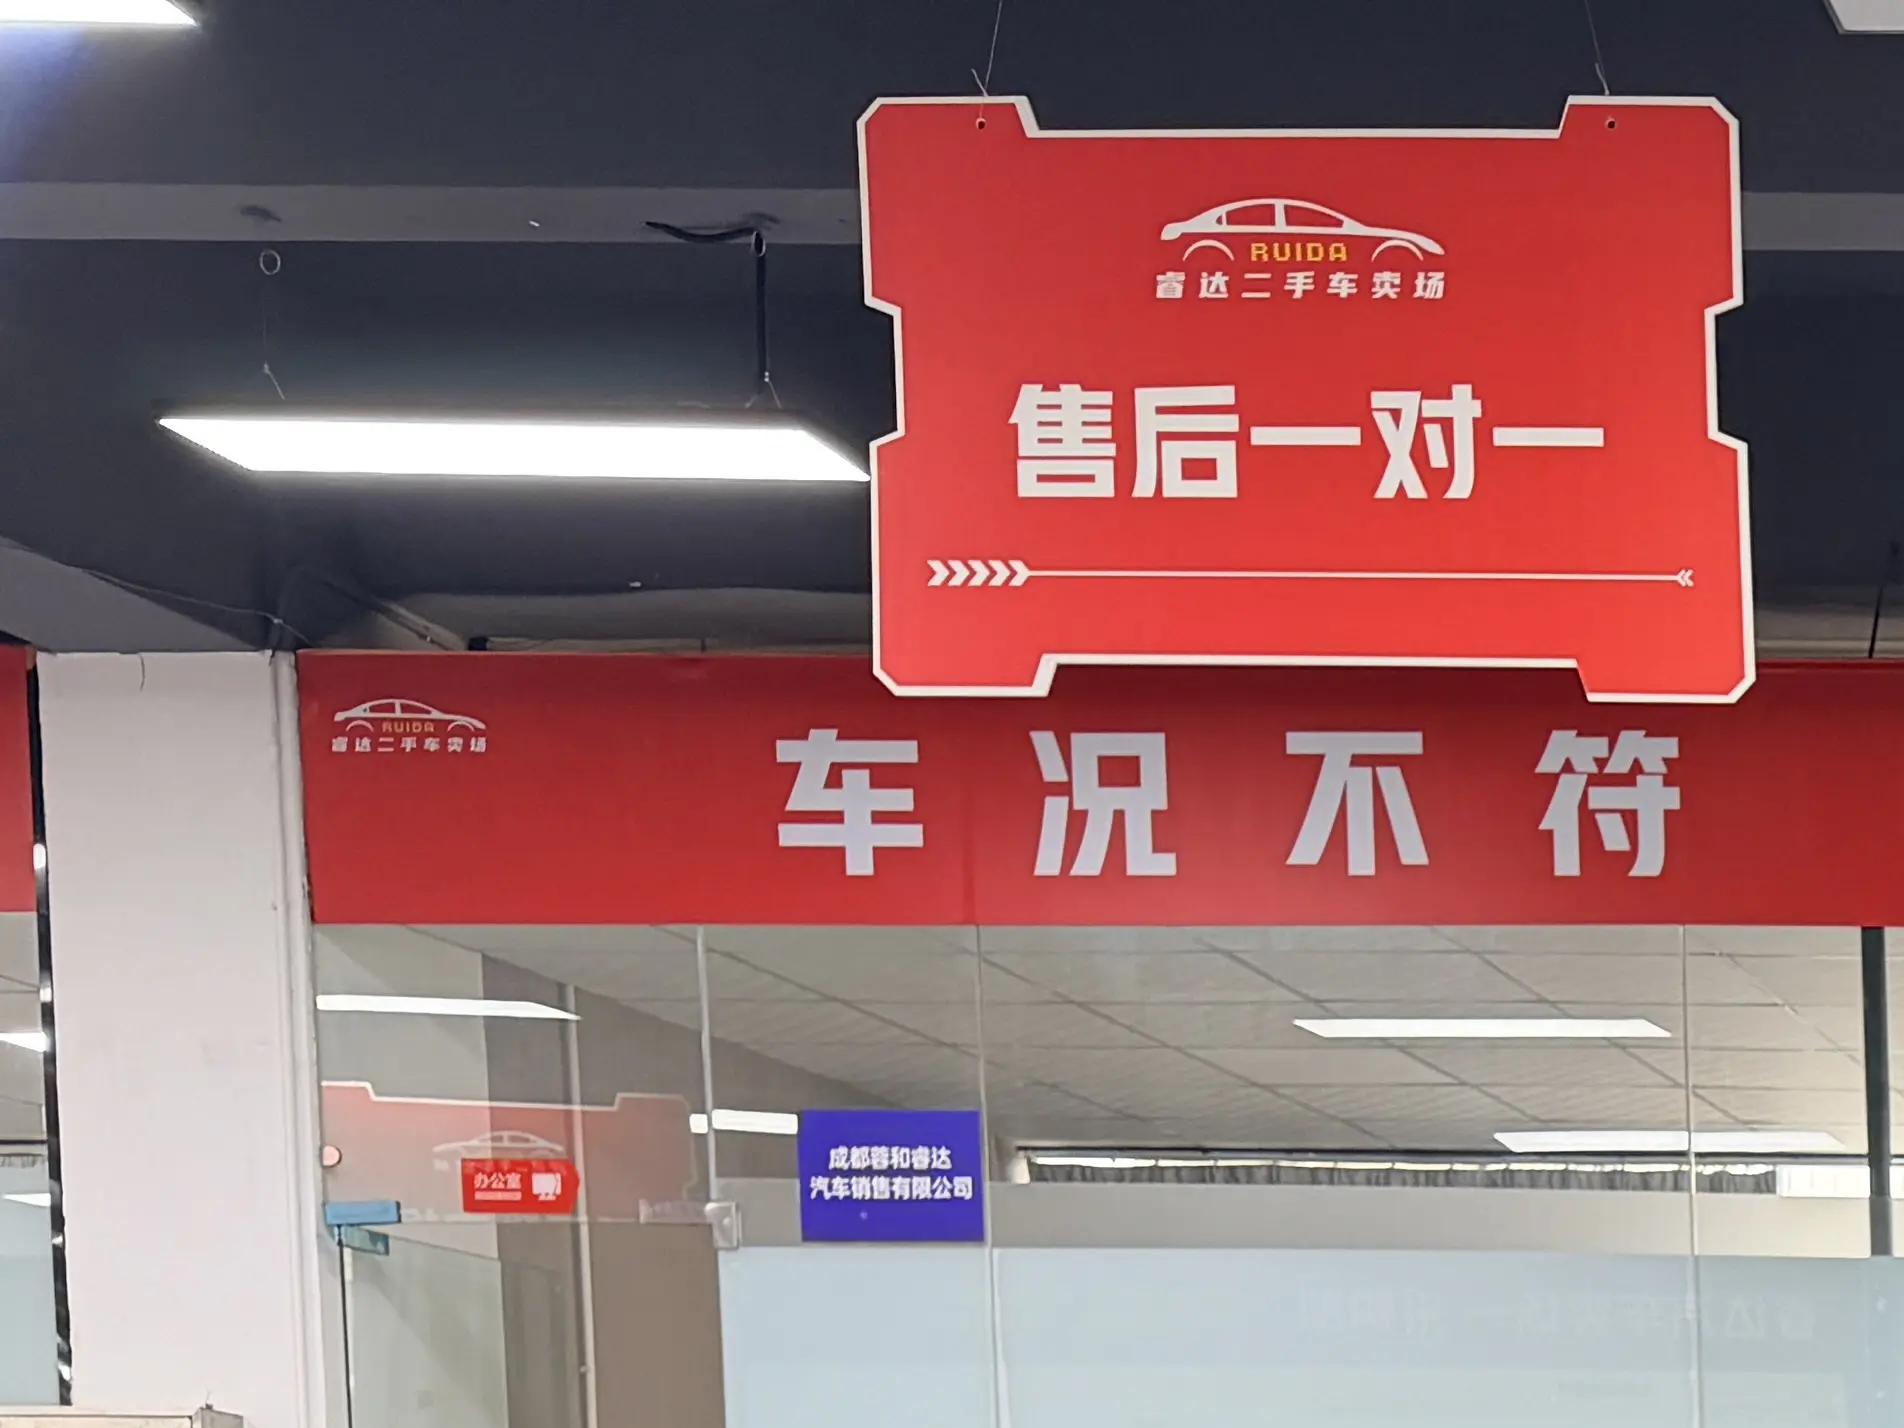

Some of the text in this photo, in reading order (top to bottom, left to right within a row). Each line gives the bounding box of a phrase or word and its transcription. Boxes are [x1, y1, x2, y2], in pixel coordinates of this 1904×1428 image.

[1250, 241, 1348, 263] RUIDA
[1155, 270, 1446, 300] 睿达二手车卖场
[1008, 383, 1605, 500] 售后一对一
[381, 720, 435, 734] RUIDA
[775, 727, 1682, 878] 车况不符
[810, 1175, 973, 1201] 汽车销售有限公司
